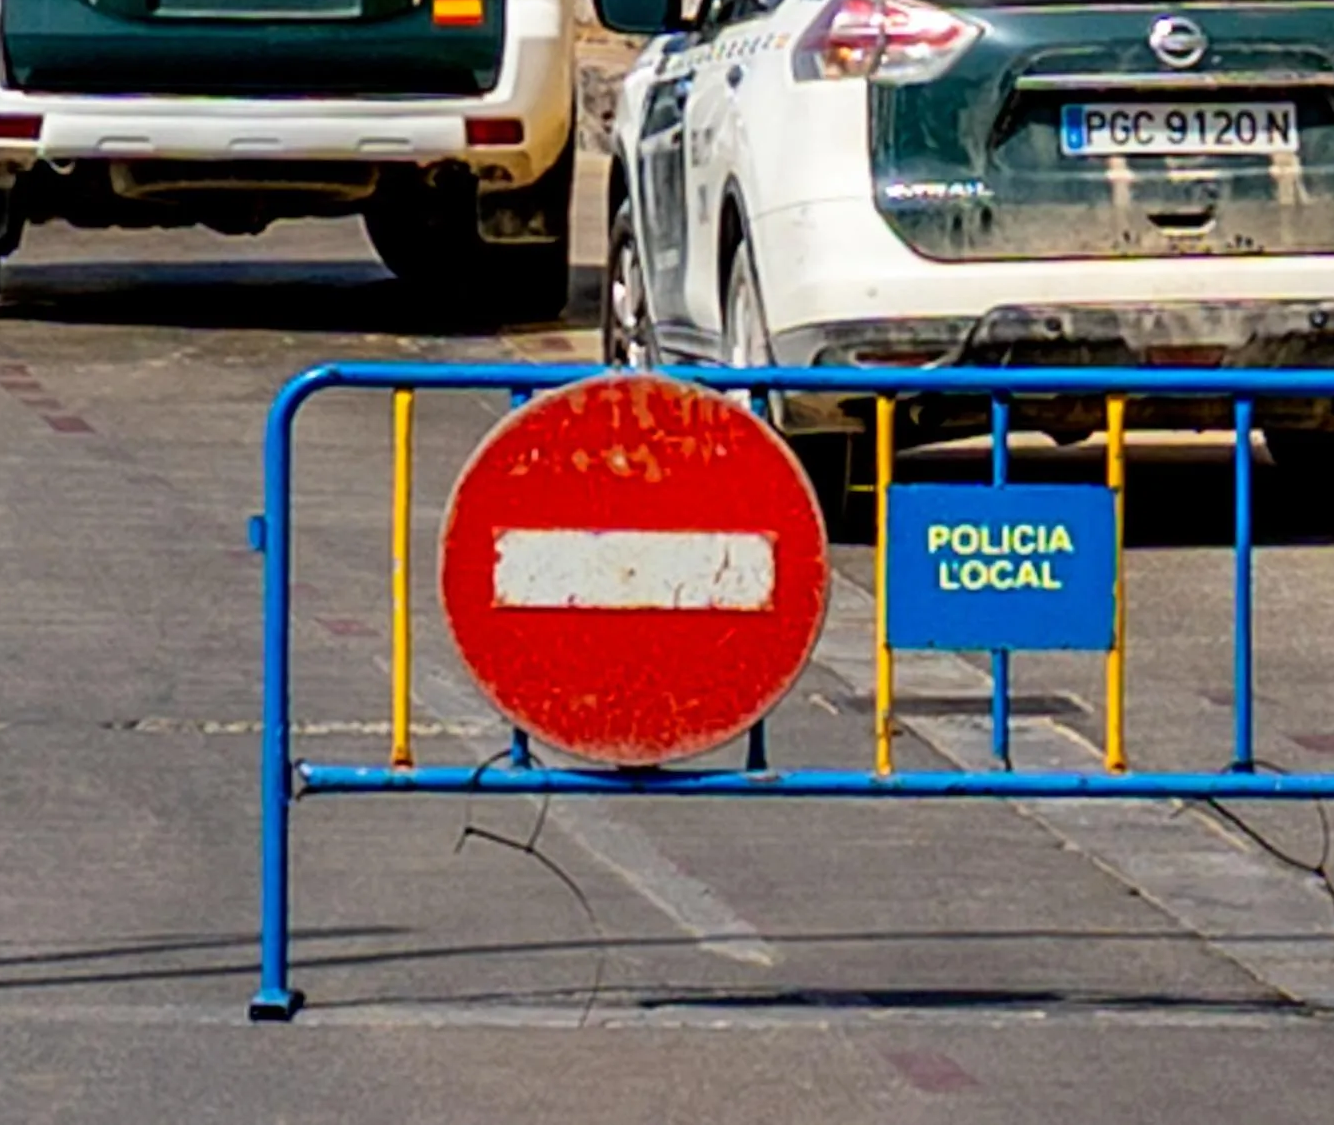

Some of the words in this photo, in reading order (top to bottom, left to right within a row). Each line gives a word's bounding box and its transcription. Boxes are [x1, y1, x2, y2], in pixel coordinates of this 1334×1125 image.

[1085, 109, 1156, 146] PGC
[1164, 108, 1259, 146] 9120
[1266, 109, 1291, 145] N
[927, 523, 1075, 556] POLICIA
[938, 559, 1063, 591] LOCAL
